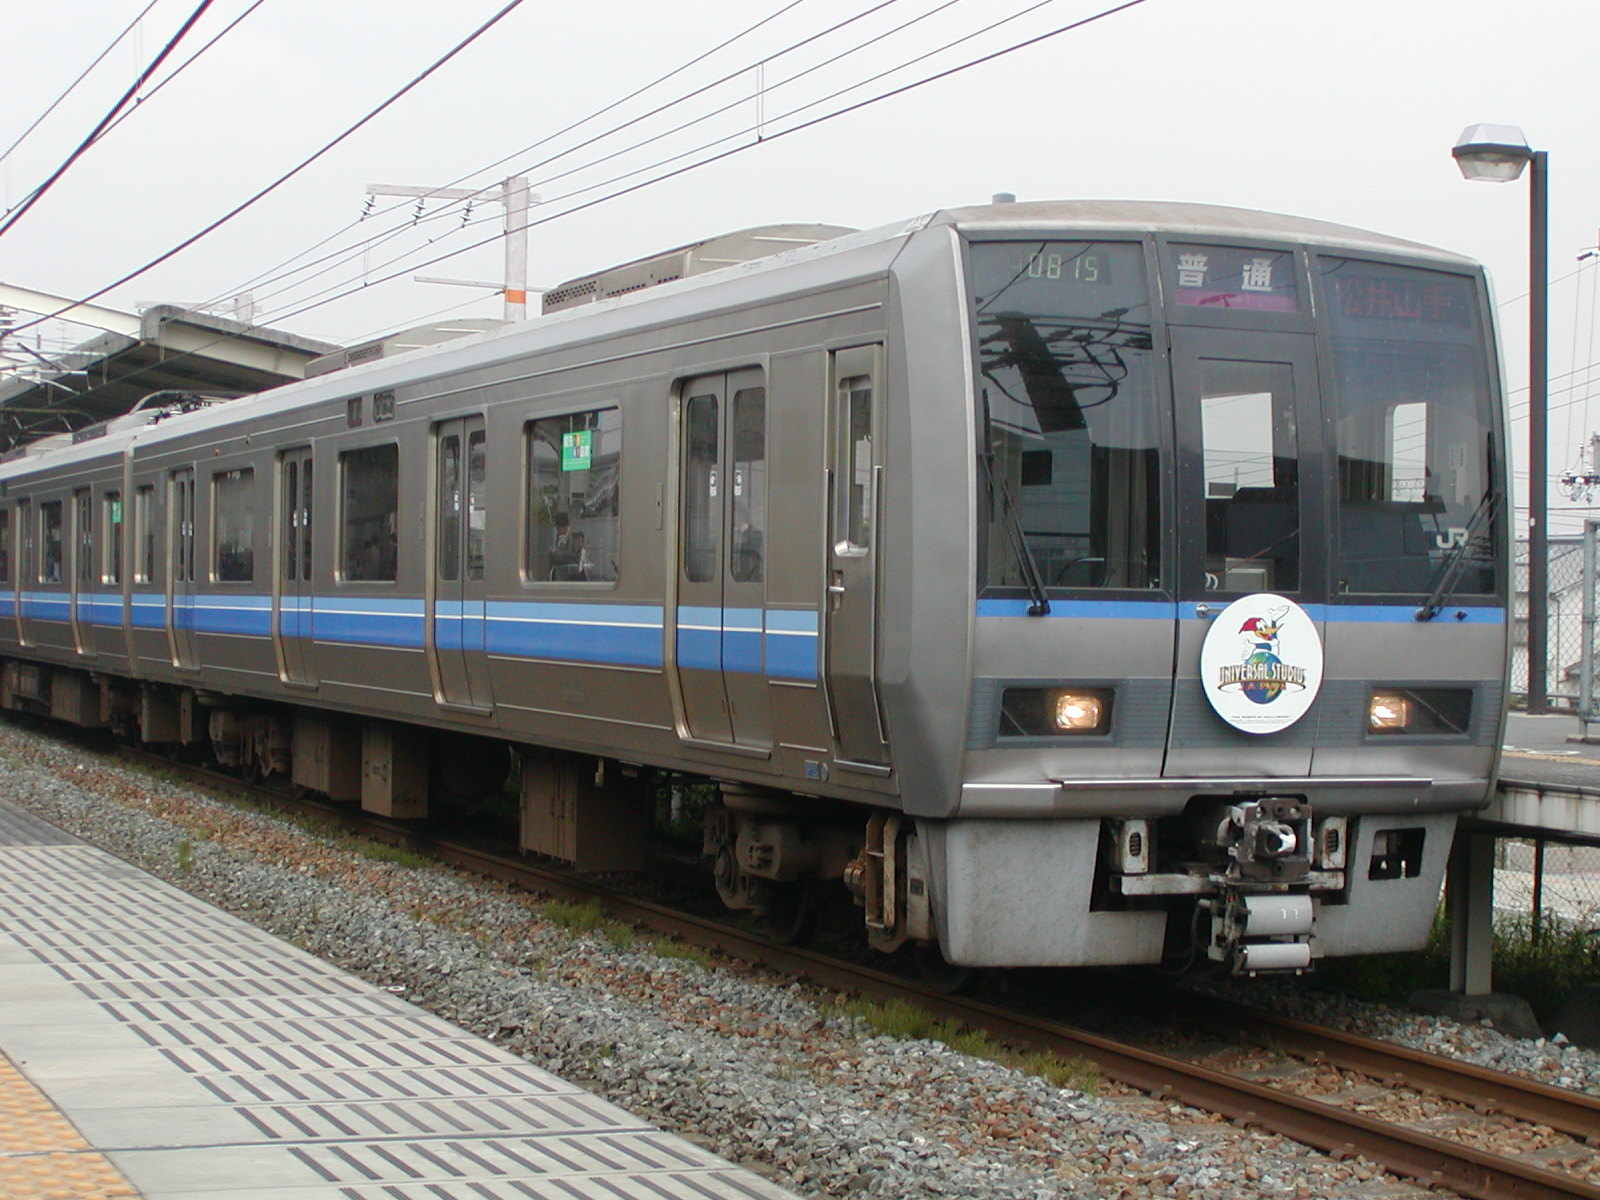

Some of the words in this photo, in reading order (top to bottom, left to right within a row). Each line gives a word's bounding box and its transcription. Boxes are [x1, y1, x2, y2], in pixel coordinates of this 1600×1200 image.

[1177, 253, 1273, 292] 普通
[1436, 527, 1470, 549] JR
[1219, 663, 1269, 683] UNIVERSAL
